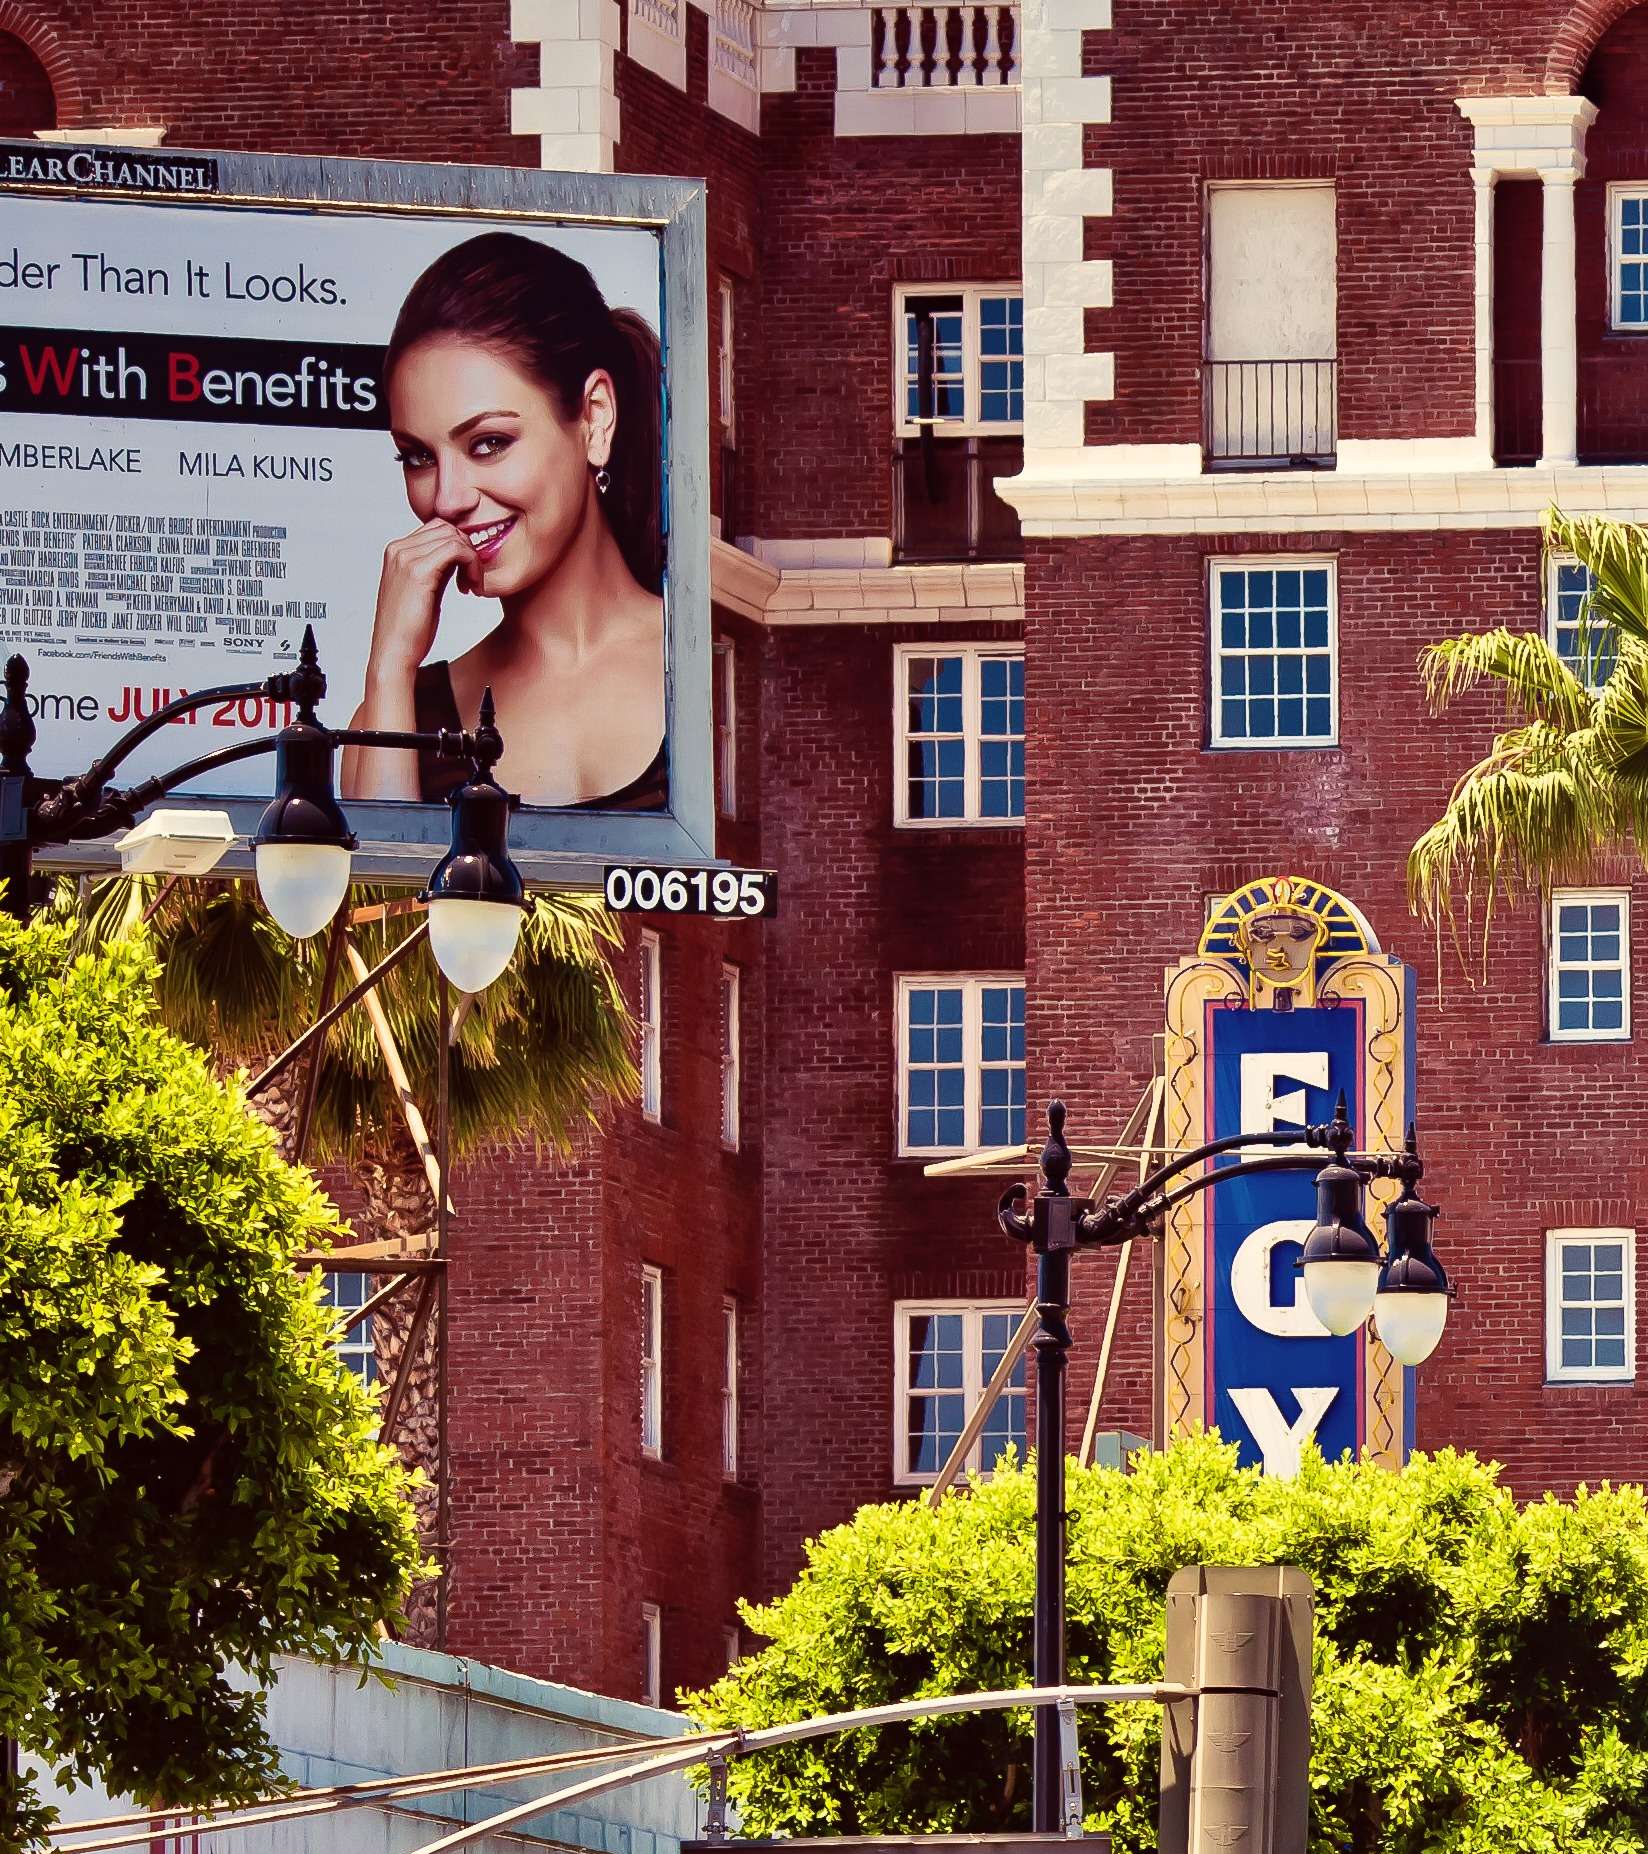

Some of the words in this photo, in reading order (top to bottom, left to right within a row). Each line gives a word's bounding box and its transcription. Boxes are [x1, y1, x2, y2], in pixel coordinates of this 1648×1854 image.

[72, 253, 169, 297] Than
[186, 259, 210, 299] It
[225, 262, 347, 305] Looks.
[19, 344, 147, 399] With
[168, 352, 377, 412] Benefits
[179, 451, 245, 478] MILA
[253, 454, 333, 482] KUNIS
[5, 510, 28, 528] CASTLE
[32, 511, 50, 529] ROCK
[197, 518, 251, 538] ENTERTAINMENT
[23, 530, 41, 548] WITH
[157, 537, 180, 555] JENNA
[241, 540, 281, 559] GREENBERG
[10, 551, 35, 567] WOODY
[150, 574, 173, 593] GRADY
[202, 578, 224, 595] GLENN
[33, 589, 53, 607] DAVID
[66, 591, 99, 609] NEWMAN
[203, 596, 224, 614] DAVID
[236, 598, 270, 617] NEWMAN
[81, 611, 108, 629] ZUCKER
[112, 612, 133, 630] JANET
[136, 613, 162, 631] ZUCKER
[224, 637, 265, 648] SONY
[606, 869, 766, 914] 006195
